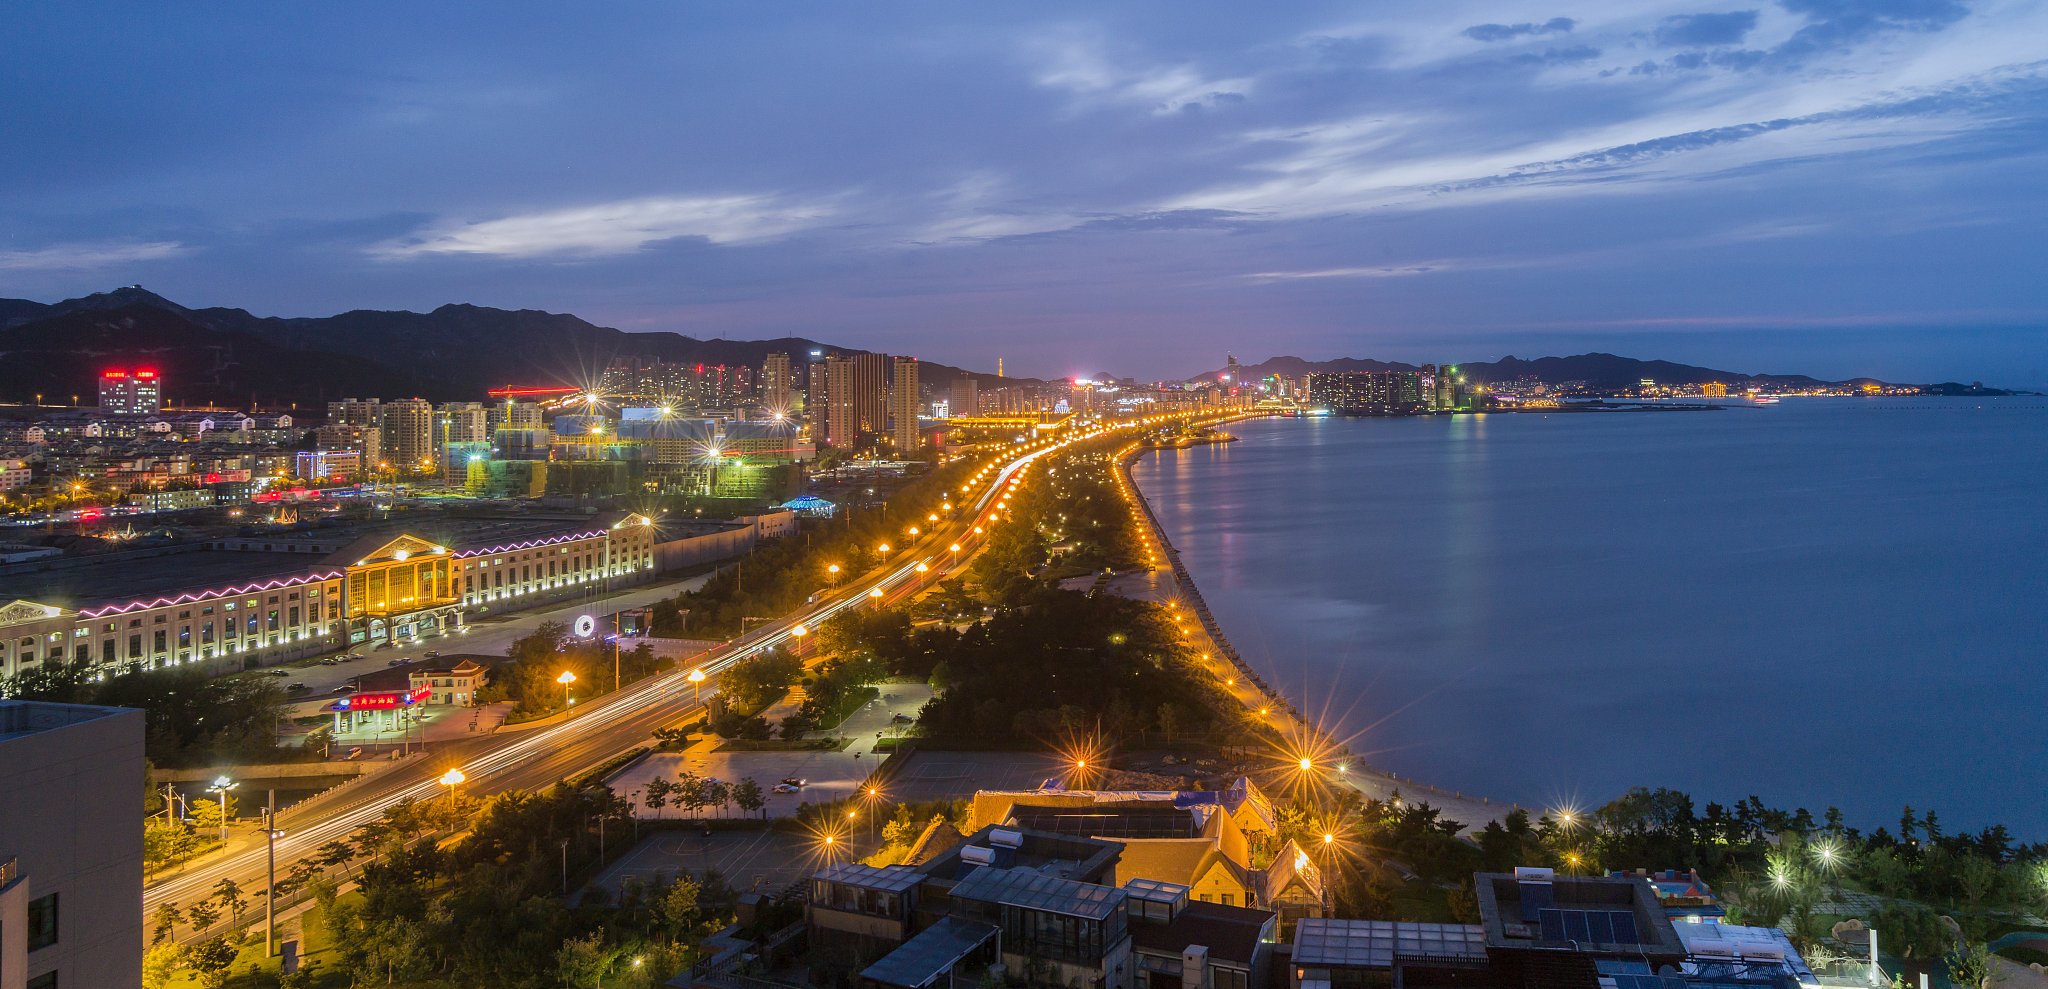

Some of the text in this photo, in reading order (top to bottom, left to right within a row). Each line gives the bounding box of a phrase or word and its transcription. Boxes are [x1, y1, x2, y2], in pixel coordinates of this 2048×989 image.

[351, 697, 394, 706] 三角加油站
